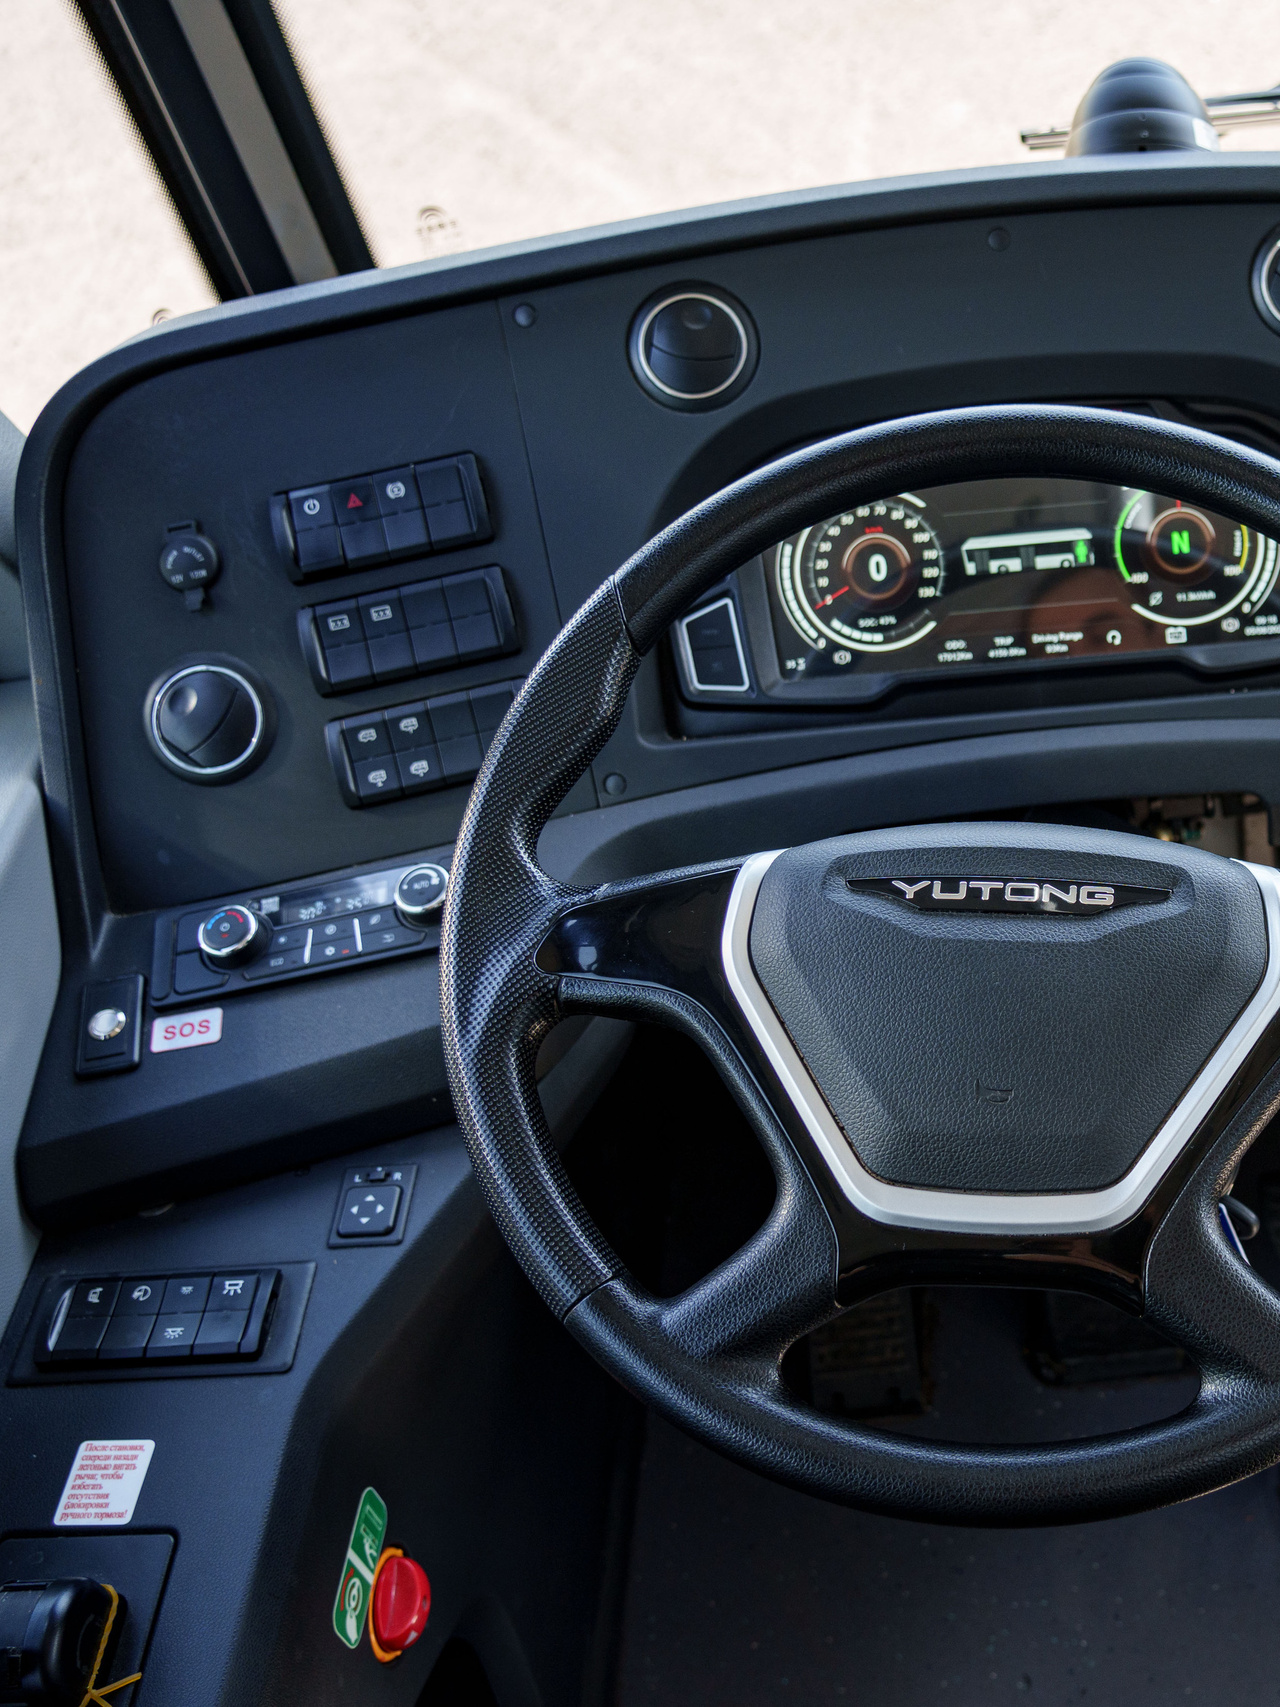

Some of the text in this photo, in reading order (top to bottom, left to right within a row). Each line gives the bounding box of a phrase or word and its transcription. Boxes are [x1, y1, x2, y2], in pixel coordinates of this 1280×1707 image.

[856, 506, 870, 518] 60
[873, 505, 887, 516] 70
[890, 509, 905, 520] 80
[840, 514, 855, 526] 50
[904, 518, 918, 530] 90
[827, 525, 841, 537] 40
[912, 532, 930, 543] 100
[1171, 530, 1191, 555] N
[818, 541, 832, 552] 30
[922, 549, 938, 560] 110
[815, 558, 829, 570] 20
[868, 553, 888, 582] 0
[922, 567, 940, 578] 120
[817, 576, 829, 588] 10
[918, 586, 936, 598] 130
[1031, 631, 1084, 645] Driving Range
[892, 880, 1116, 906] YUTONG
[163, 1019, 211, 1041] SOS
[354, 1171, 402, 1183] L R
[84, 1443, 109, 1452] После
[100, 1471, 124, 1480] чтобы
[70, 1482, 103, 1490] избегать
[67, 1493, 110, 1502] отсутствия
[63, 1501, 110, 1511] блокировки
[59, 1509, 128, 1522] ручного тормоза!
